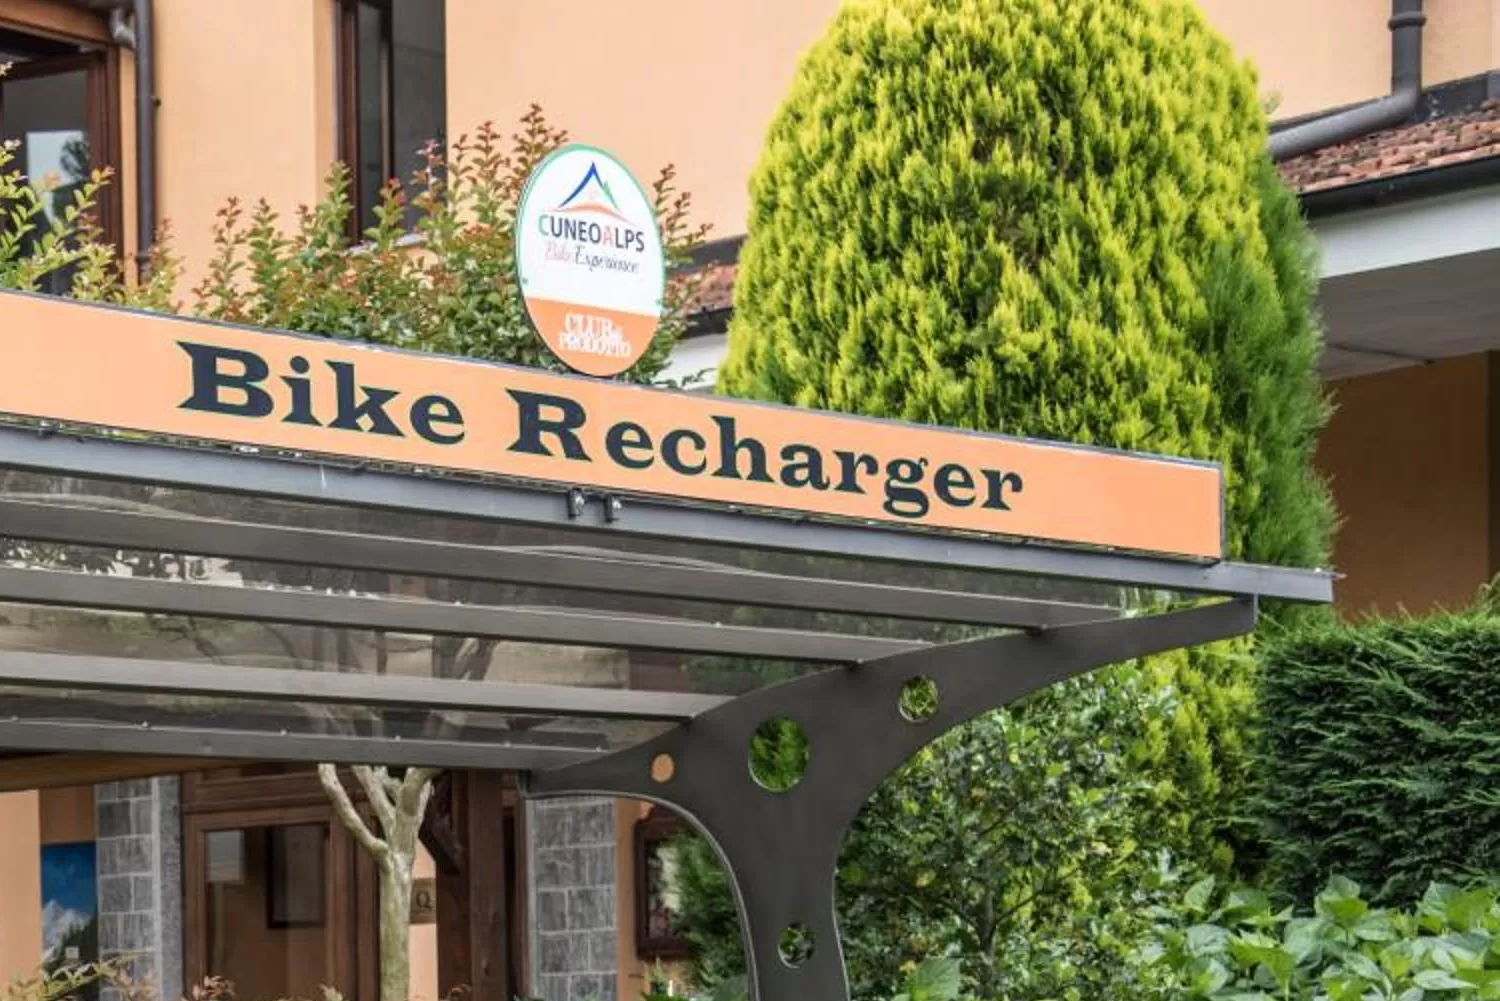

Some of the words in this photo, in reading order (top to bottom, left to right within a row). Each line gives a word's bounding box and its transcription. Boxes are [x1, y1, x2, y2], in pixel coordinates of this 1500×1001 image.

[539, 214, 645, 252] CUNEOALPS
[565, 313, 612, 338] CLUB
[176, 340, 466, 444] Bike
[505, 388, 1024, 519] Recharger
